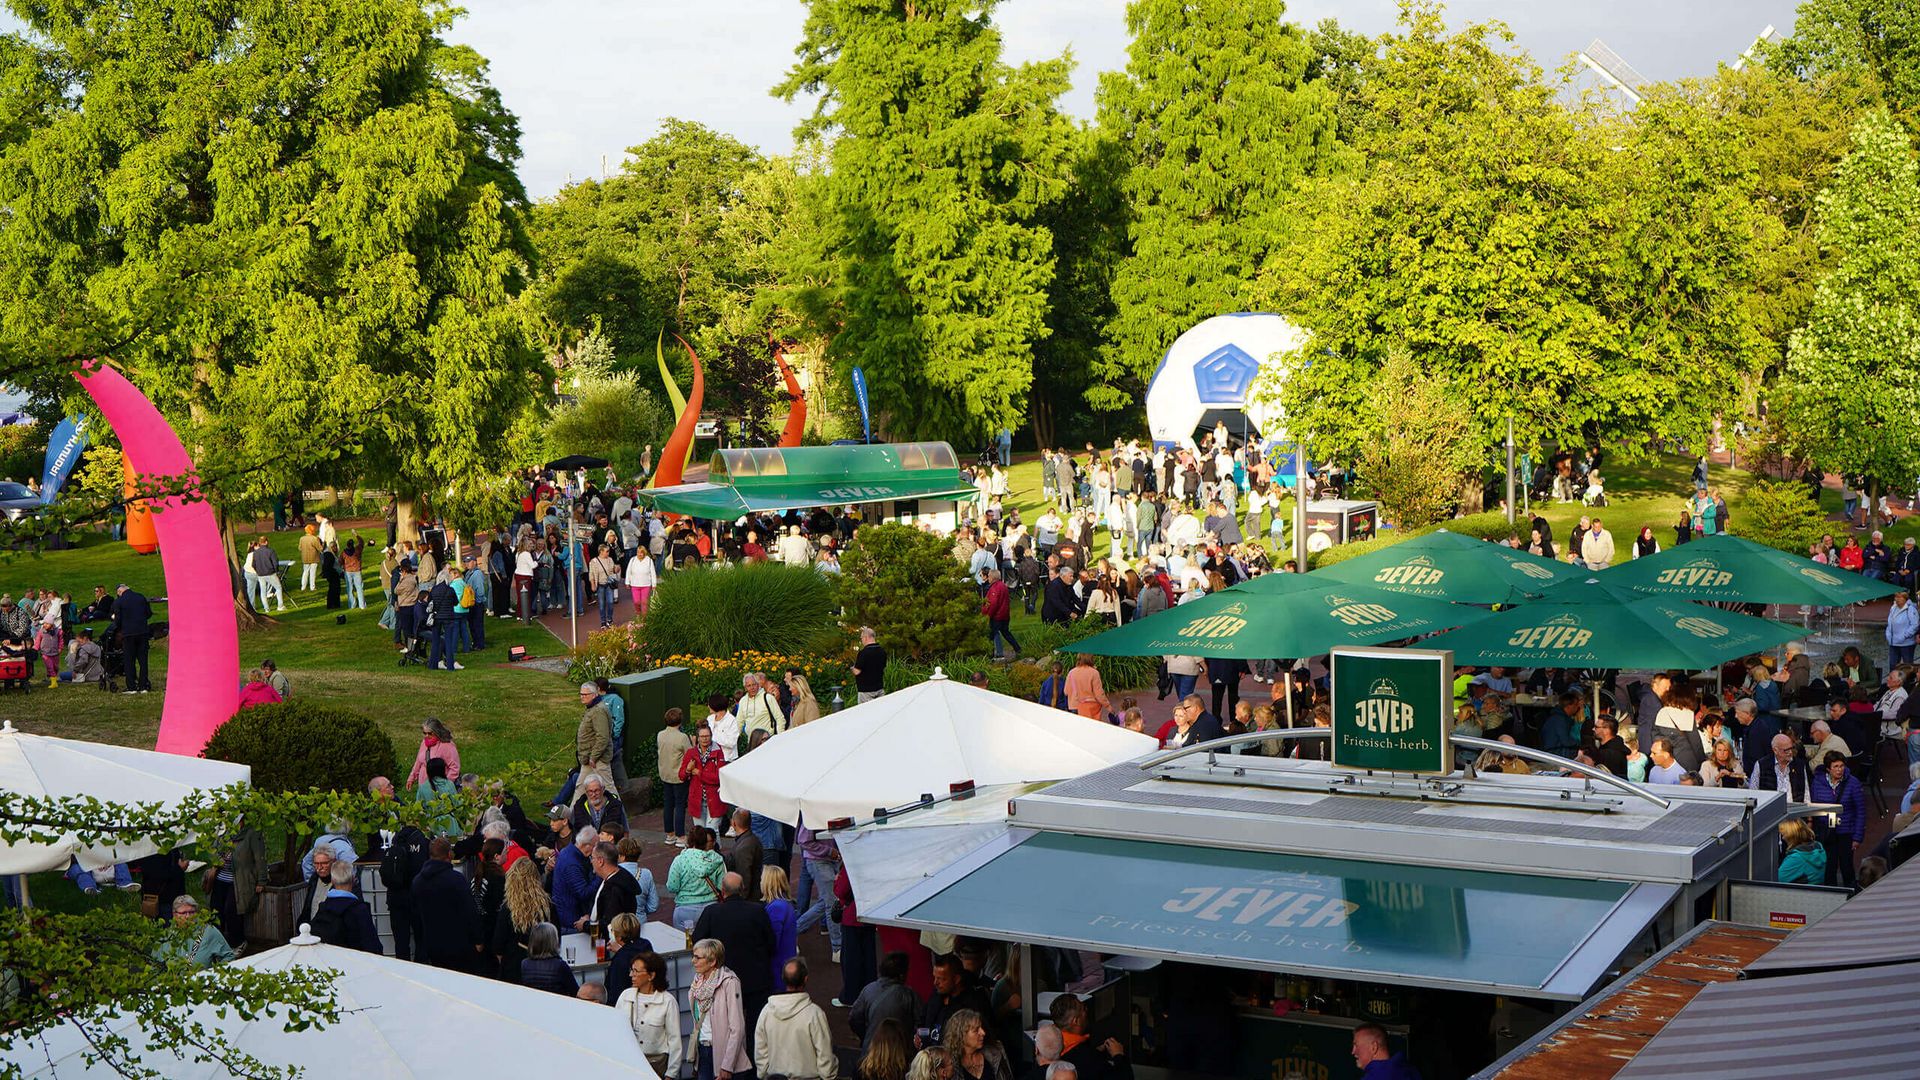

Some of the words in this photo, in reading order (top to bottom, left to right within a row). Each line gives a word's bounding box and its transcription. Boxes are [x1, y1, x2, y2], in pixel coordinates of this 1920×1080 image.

[818, 486, 894, 499] JEVER
[1374, 565, 1445, 585] JEVER
[1657, 567, 1734, 587] JEVER
[1377, 585, 1448, 597] isch-herb.
[1633, 585, 1744, 597] Friesisch-herb.
[1330, 603, 1398, 626] JEVER
[1178, 615, 1248, 638] JEVER
[1347, 618, 1433, 639] Friesisch-herb.
[1147, 639, 1235, 651] Friesisch-herb.
[1508, 625, 1593, 649] JEVER
[1478, 649, 1598, 661] Friesisch-herb.
[1355, 698, 1414, 734] JEVER
[1343, 734, 1433, 751] Friesisch-herb.
[1162, 886, 1359, 928] JEVER
[1088, 914, 1372, 955] Friesisch-herb.
[1368, 999, 1392, 1016] JEVER
